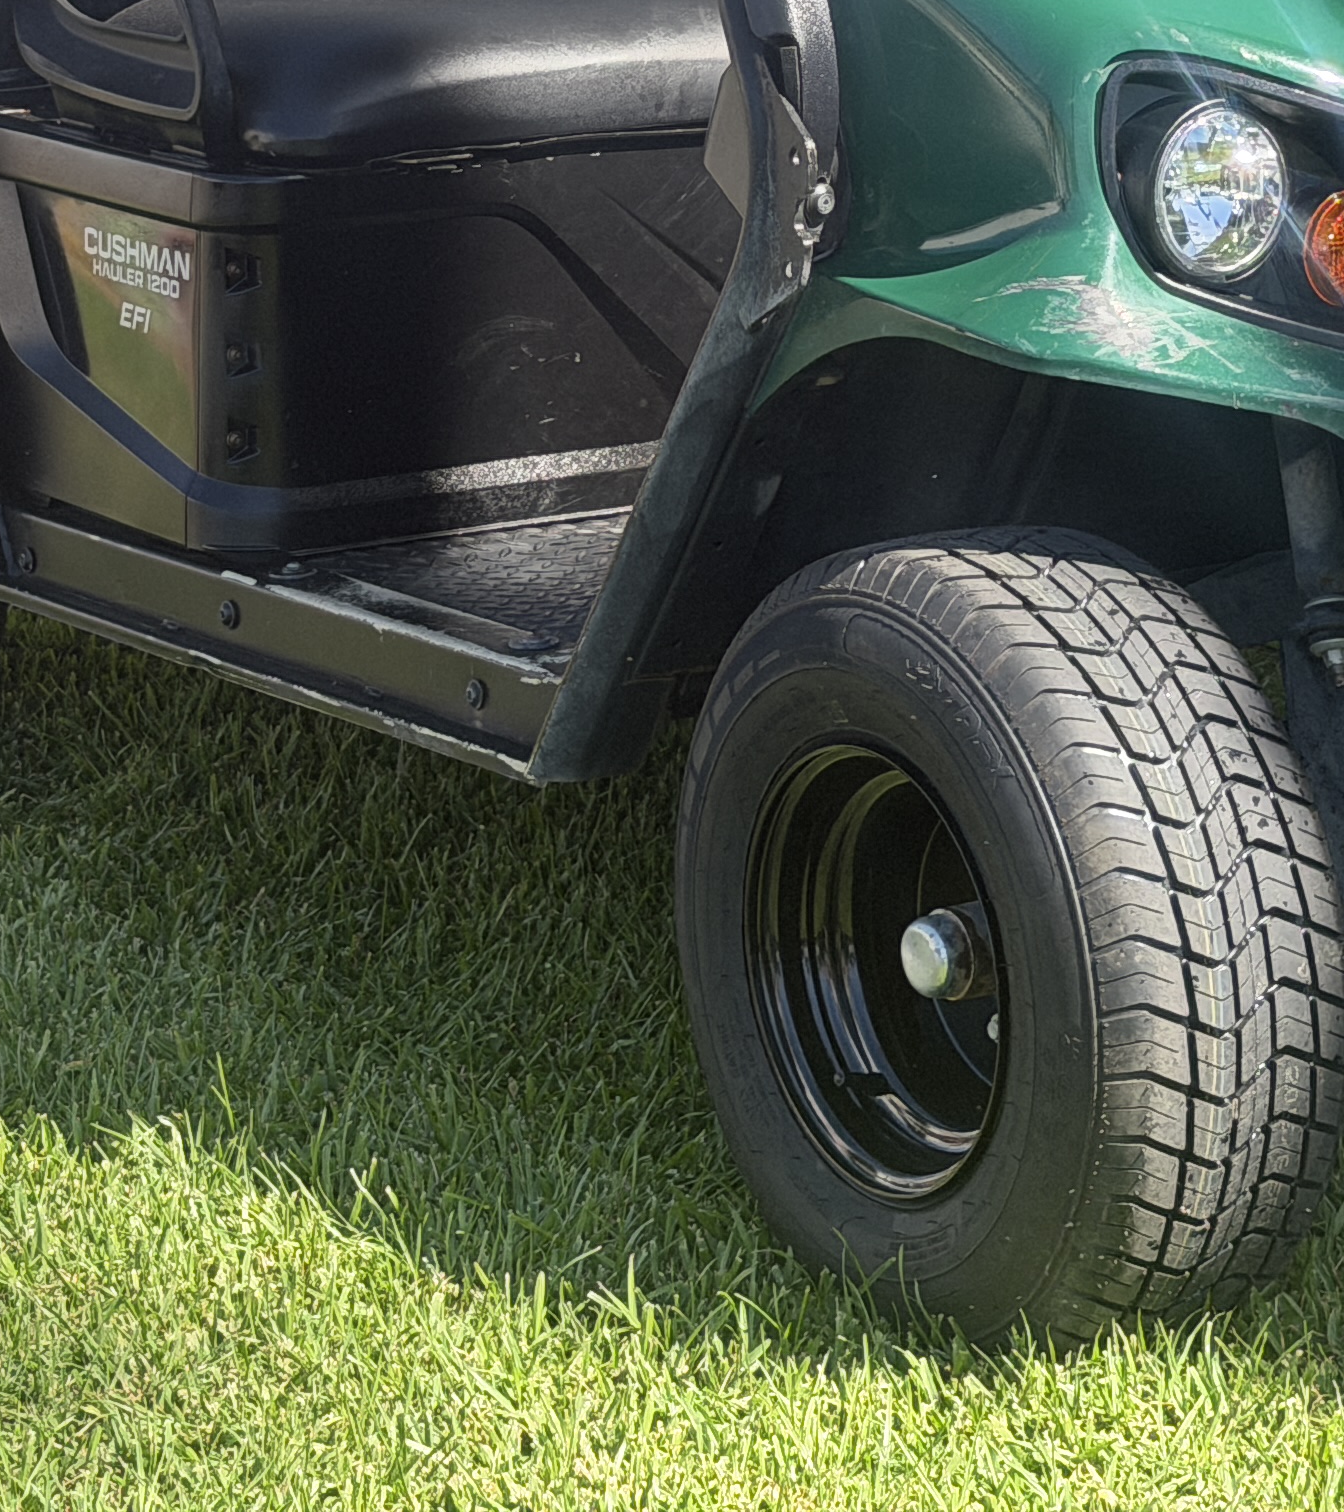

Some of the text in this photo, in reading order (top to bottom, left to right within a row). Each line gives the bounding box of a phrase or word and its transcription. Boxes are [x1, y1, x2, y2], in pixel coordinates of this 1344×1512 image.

[84, 226, 190, 281] CUSHMAN
[93, 259, 180, 299] HAULER 1200
[119, 301, 151, 334] EFI
